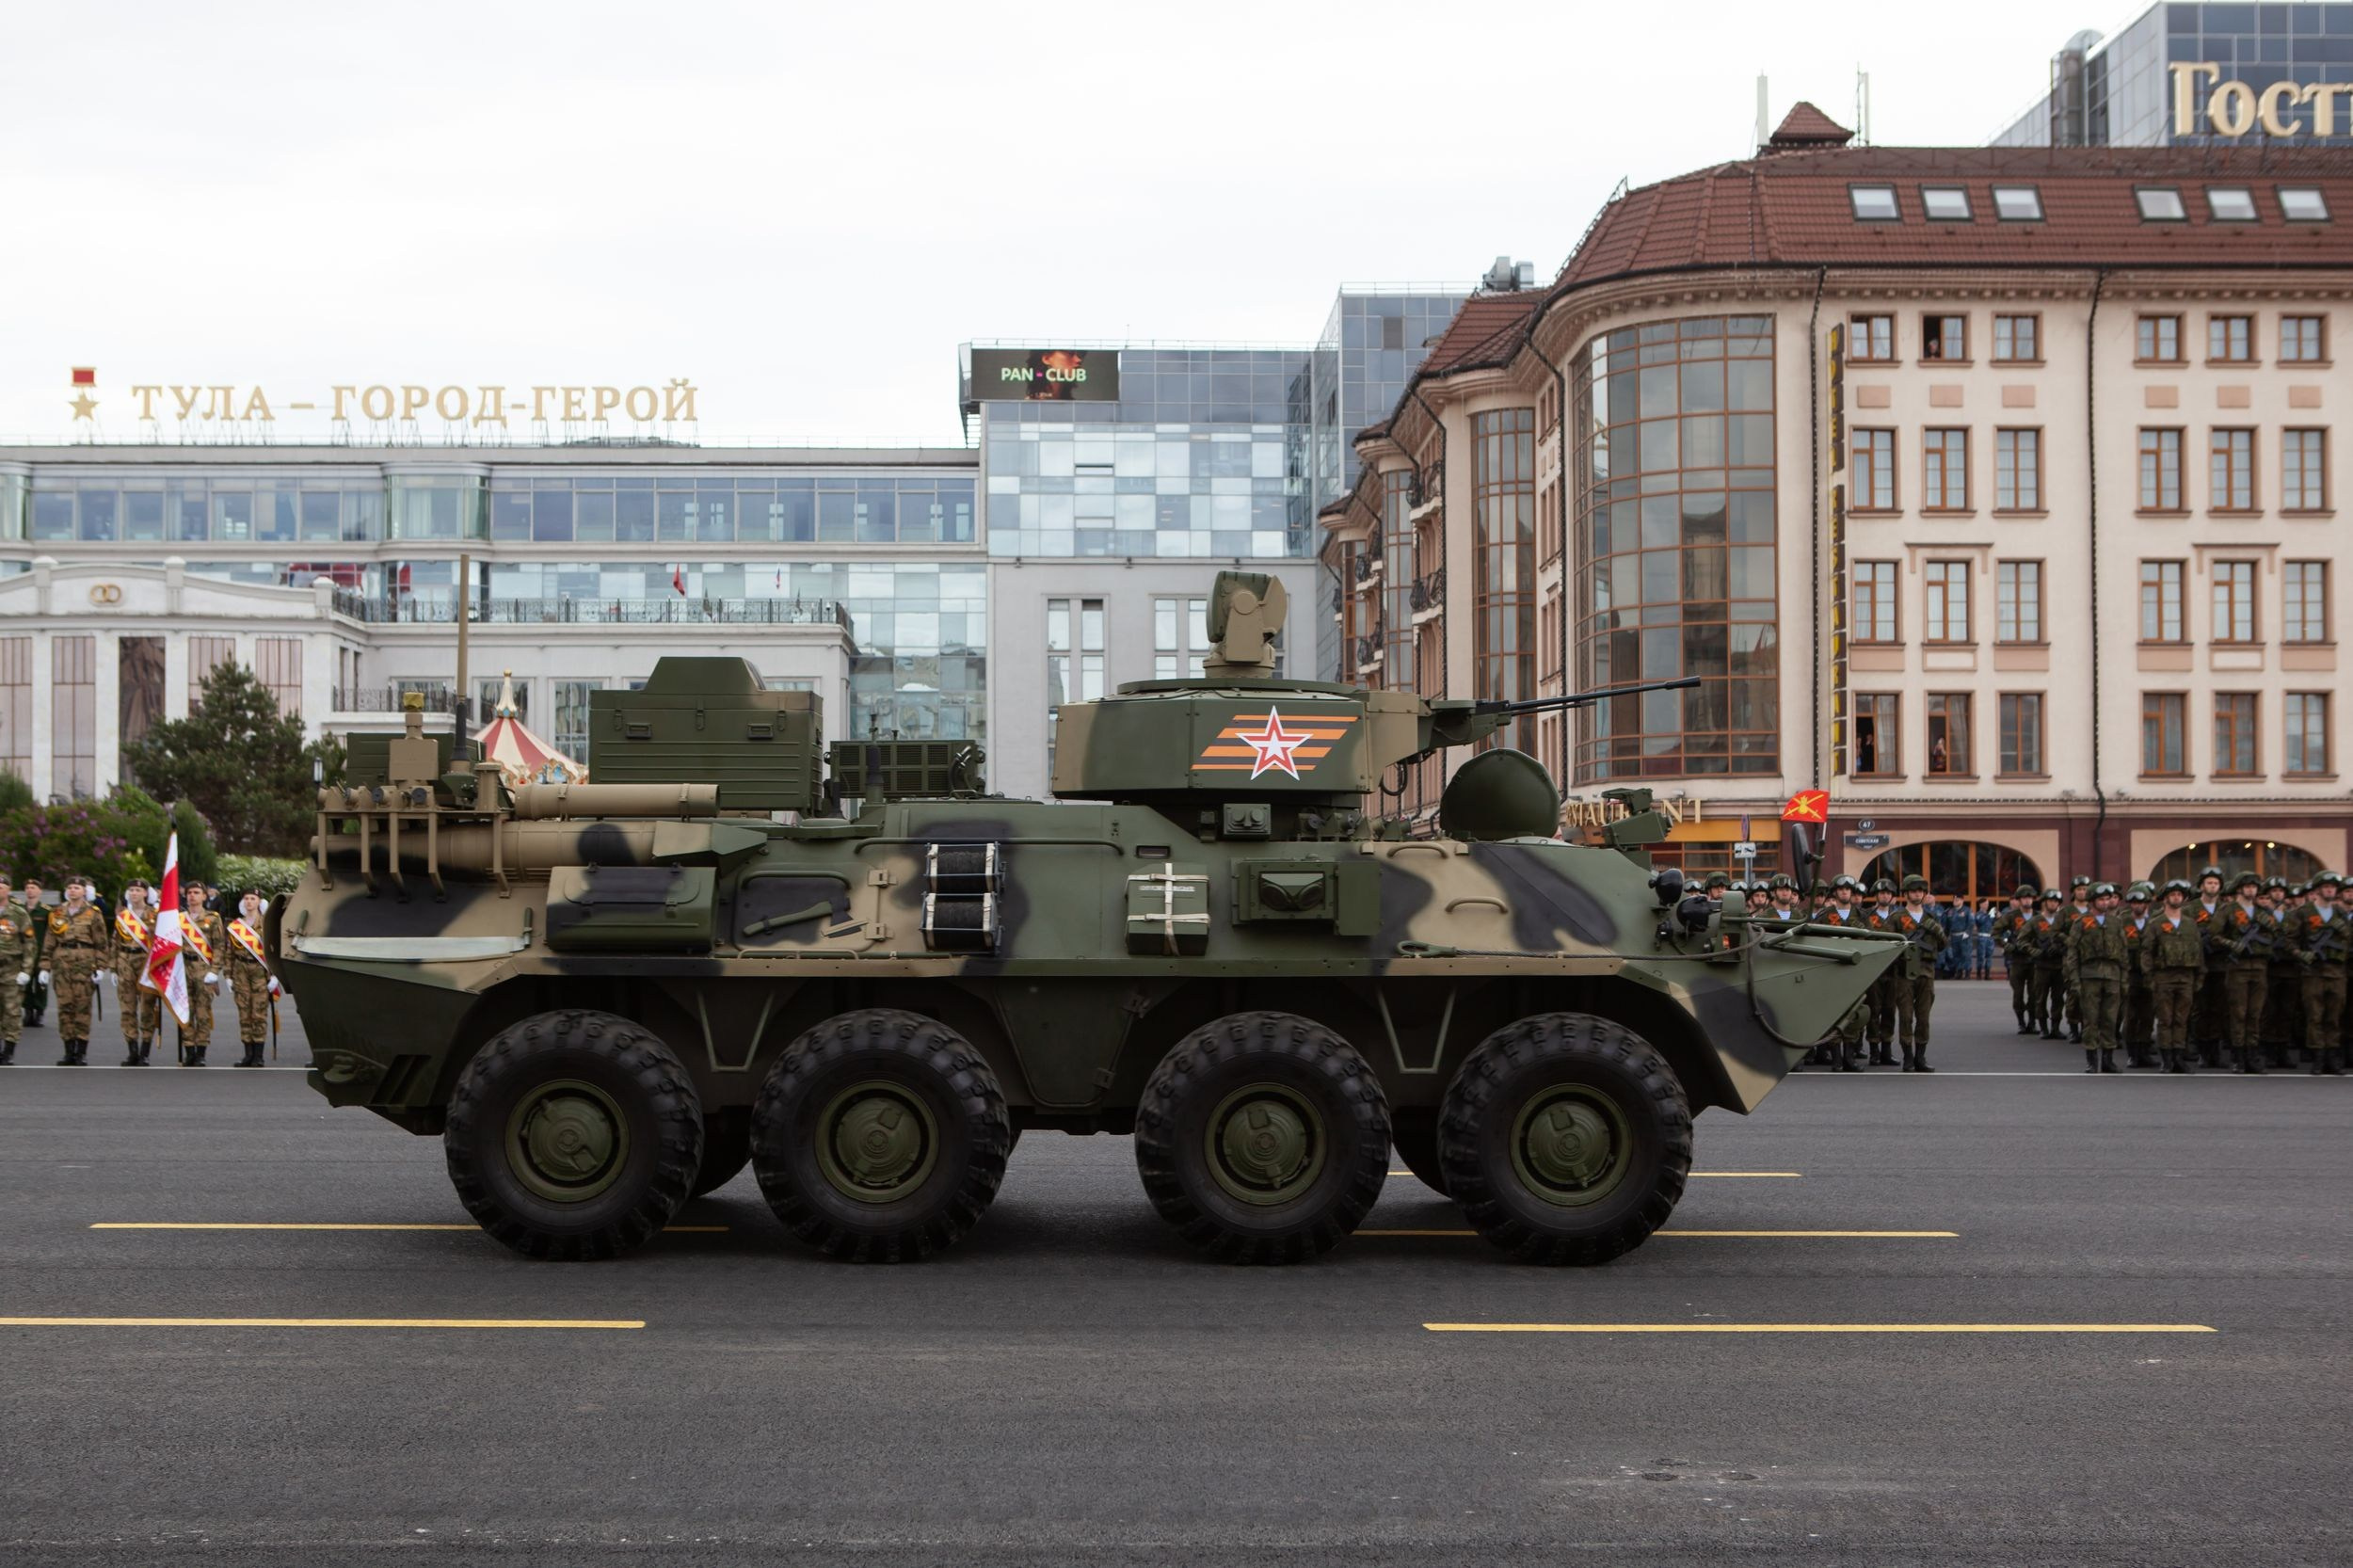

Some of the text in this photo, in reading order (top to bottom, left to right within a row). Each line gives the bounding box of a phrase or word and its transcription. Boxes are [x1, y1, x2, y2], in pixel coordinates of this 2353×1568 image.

[2169, 60, 2353, 137] Гост
[1000, 367, 1086, 382] PAN CLUB
[132, 385, 275, 421] ТУЛА
[331, 377, 698, 428] ГОРОД-ГЕРОЙ
